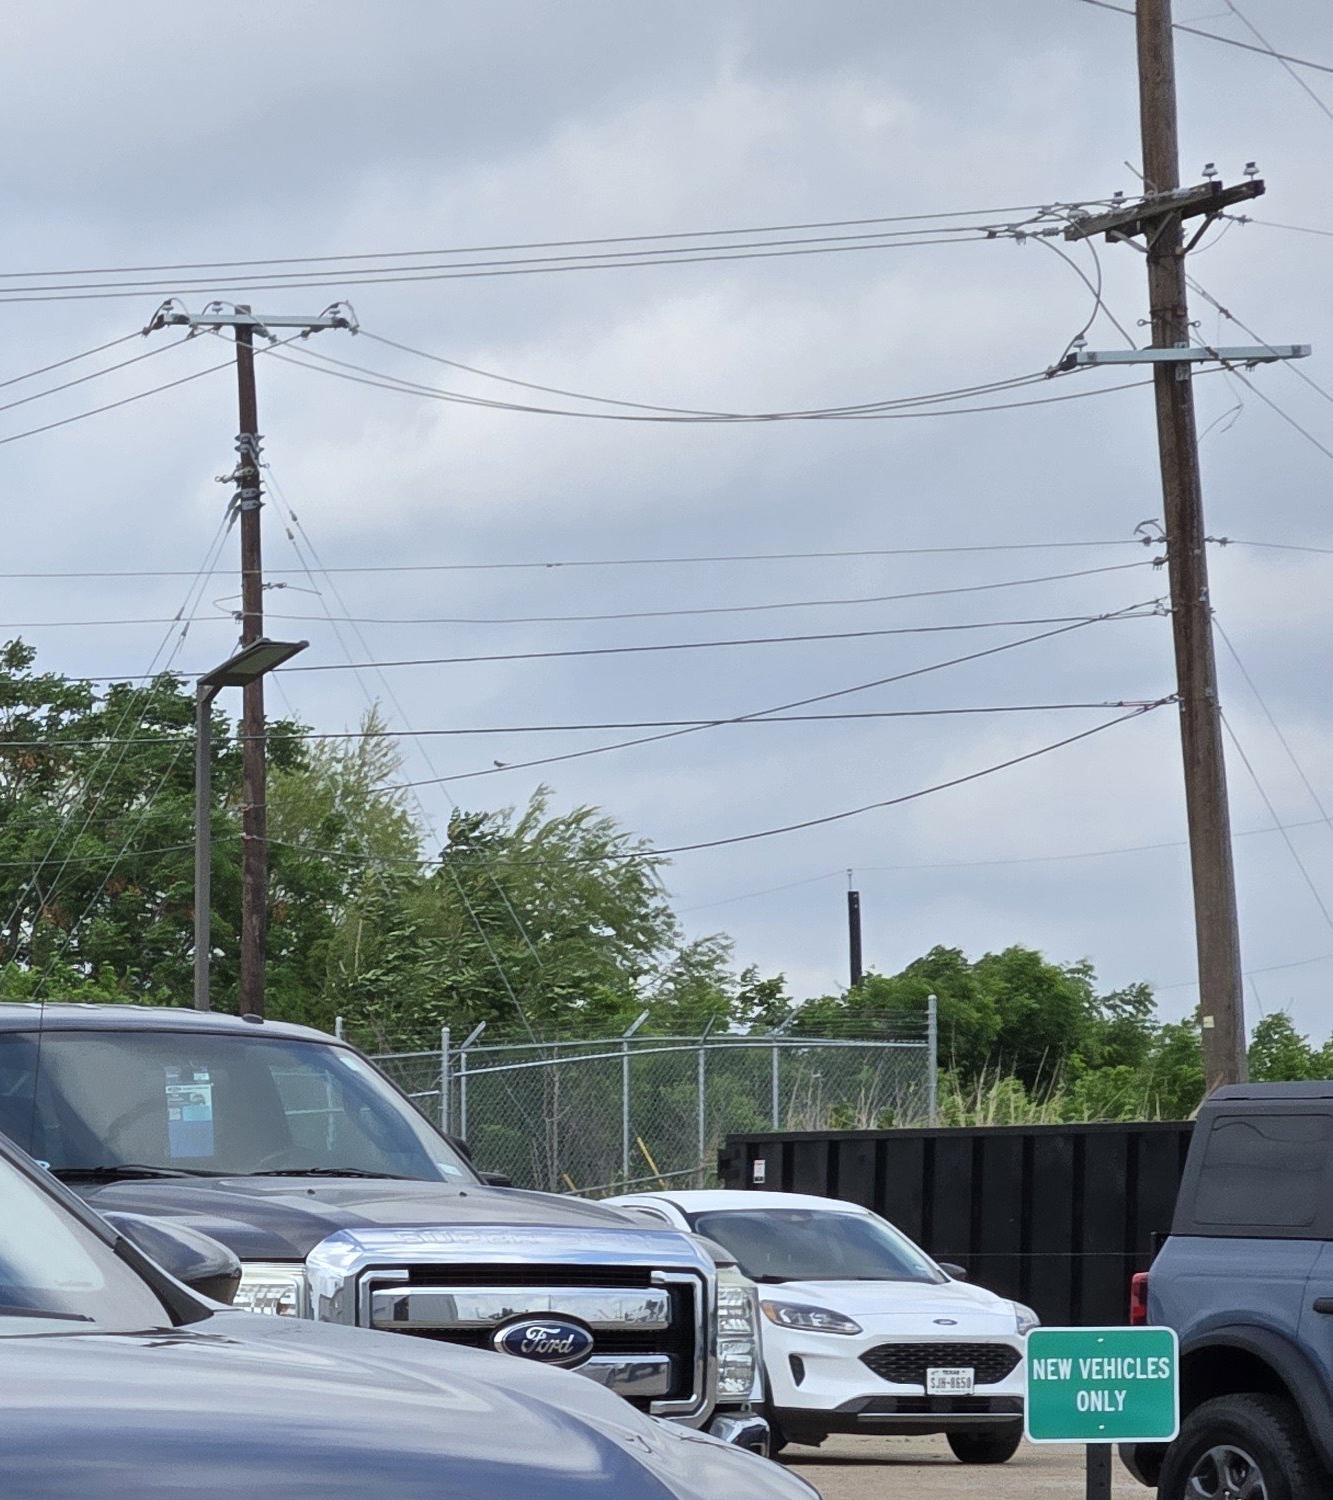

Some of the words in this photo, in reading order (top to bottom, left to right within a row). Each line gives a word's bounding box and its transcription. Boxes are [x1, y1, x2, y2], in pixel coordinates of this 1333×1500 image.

[520, 1326, 575, 1354] Ford
[1033, 1358, 1073, 1380] NEW
[1079, 1357, 1171, 1379] VEHICLES
[1076, 1390, 1127, 1412] ONLY
